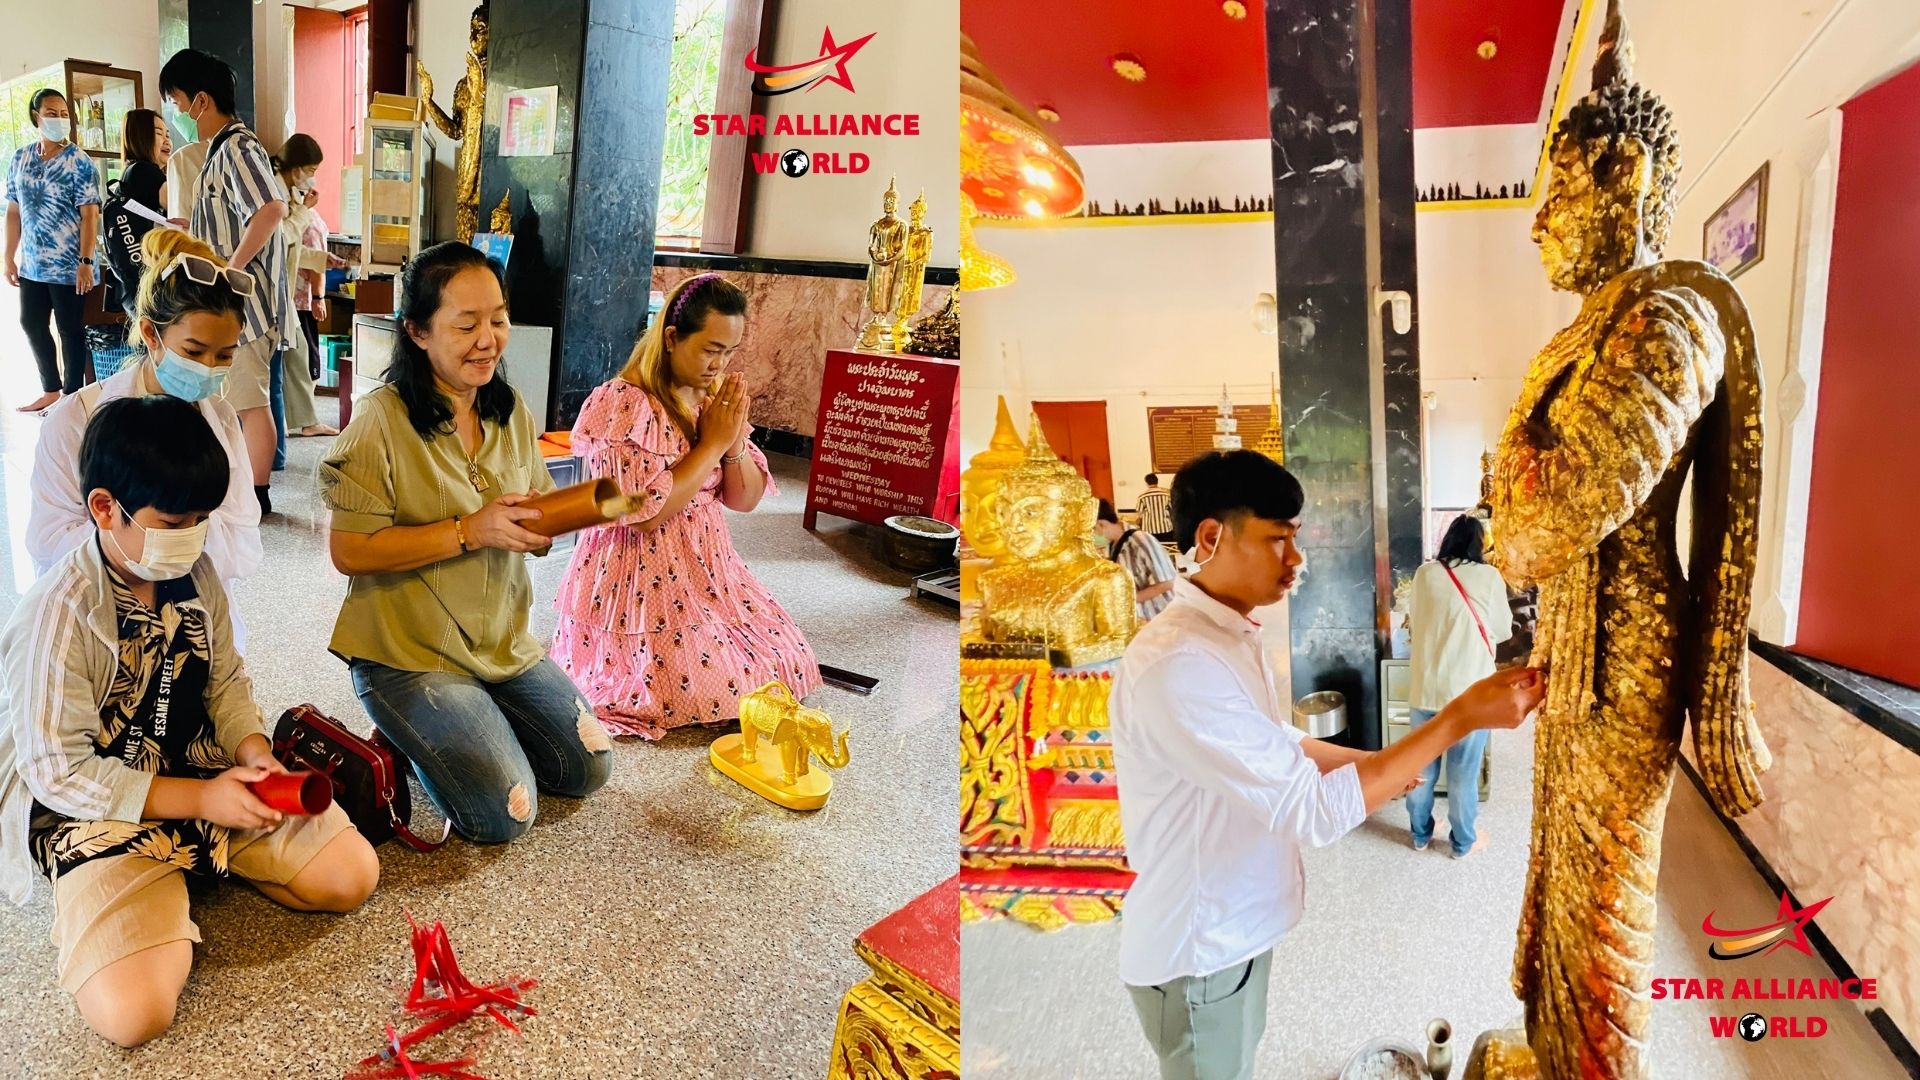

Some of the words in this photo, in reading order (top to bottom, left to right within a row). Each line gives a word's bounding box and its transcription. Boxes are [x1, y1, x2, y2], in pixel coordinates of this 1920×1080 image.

[116, 214, 142, 263] anello
[841, 470, 891, 488] WEDNESDAY
[814, 495, 828, 505] AND
[841, 490, 855, 501] WILL
[856, 494, 872, 505] HAVE
[873, 498, 889, 509] RICH
[892, 503, 920, 515] WEALTH
[855, 483, 872, 493] WHO
[874, 487, 904, 500] WORSHIP
[907, 494, 924, 505] THIS
[159, 657, 174, 695] STREET
[154, 696, 170, 737] SESAME
[129, 725, 144, 738] ST
[122, 738, 141, 766] SAME
